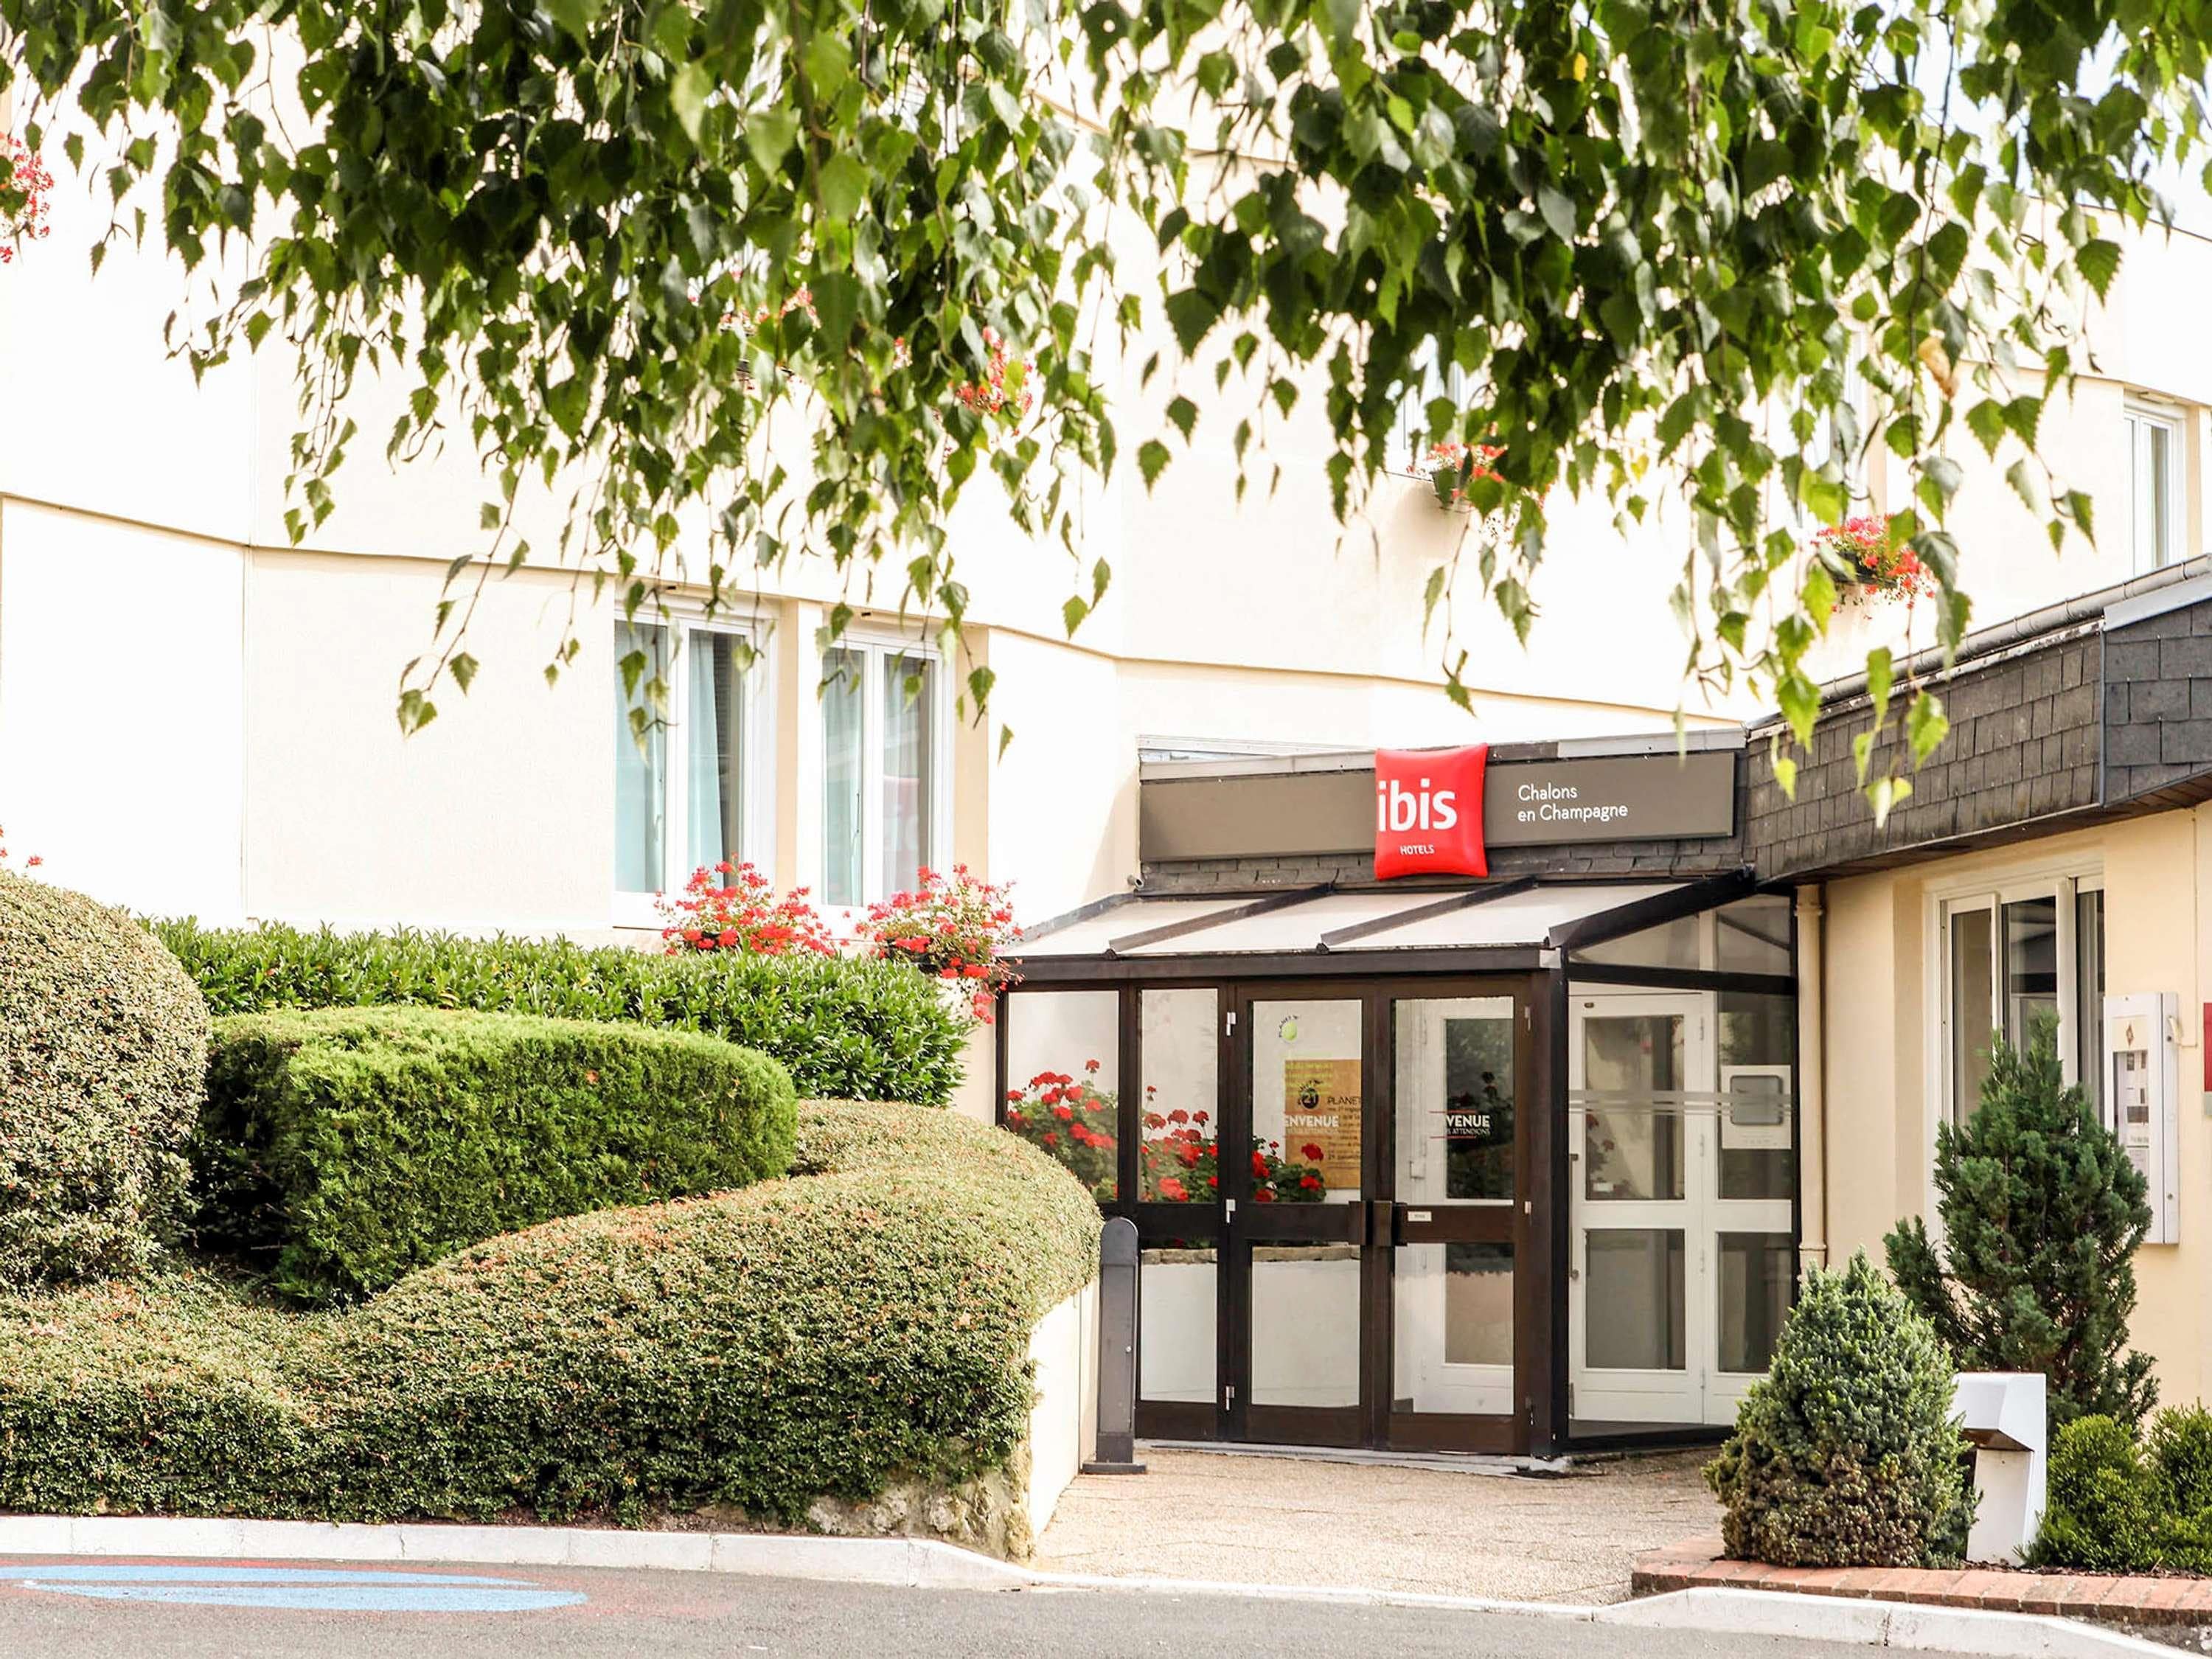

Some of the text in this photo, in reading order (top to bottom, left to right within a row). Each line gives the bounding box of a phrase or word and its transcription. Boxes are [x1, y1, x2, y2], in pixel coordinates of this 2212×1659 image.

[1517, 782, 1578, 801] Chalons
[1378, 777, 1458, 832] ibis
[1517, 803, 1629, 823] en Champagne
[1399, 844, 1435, 855] HOTELS
